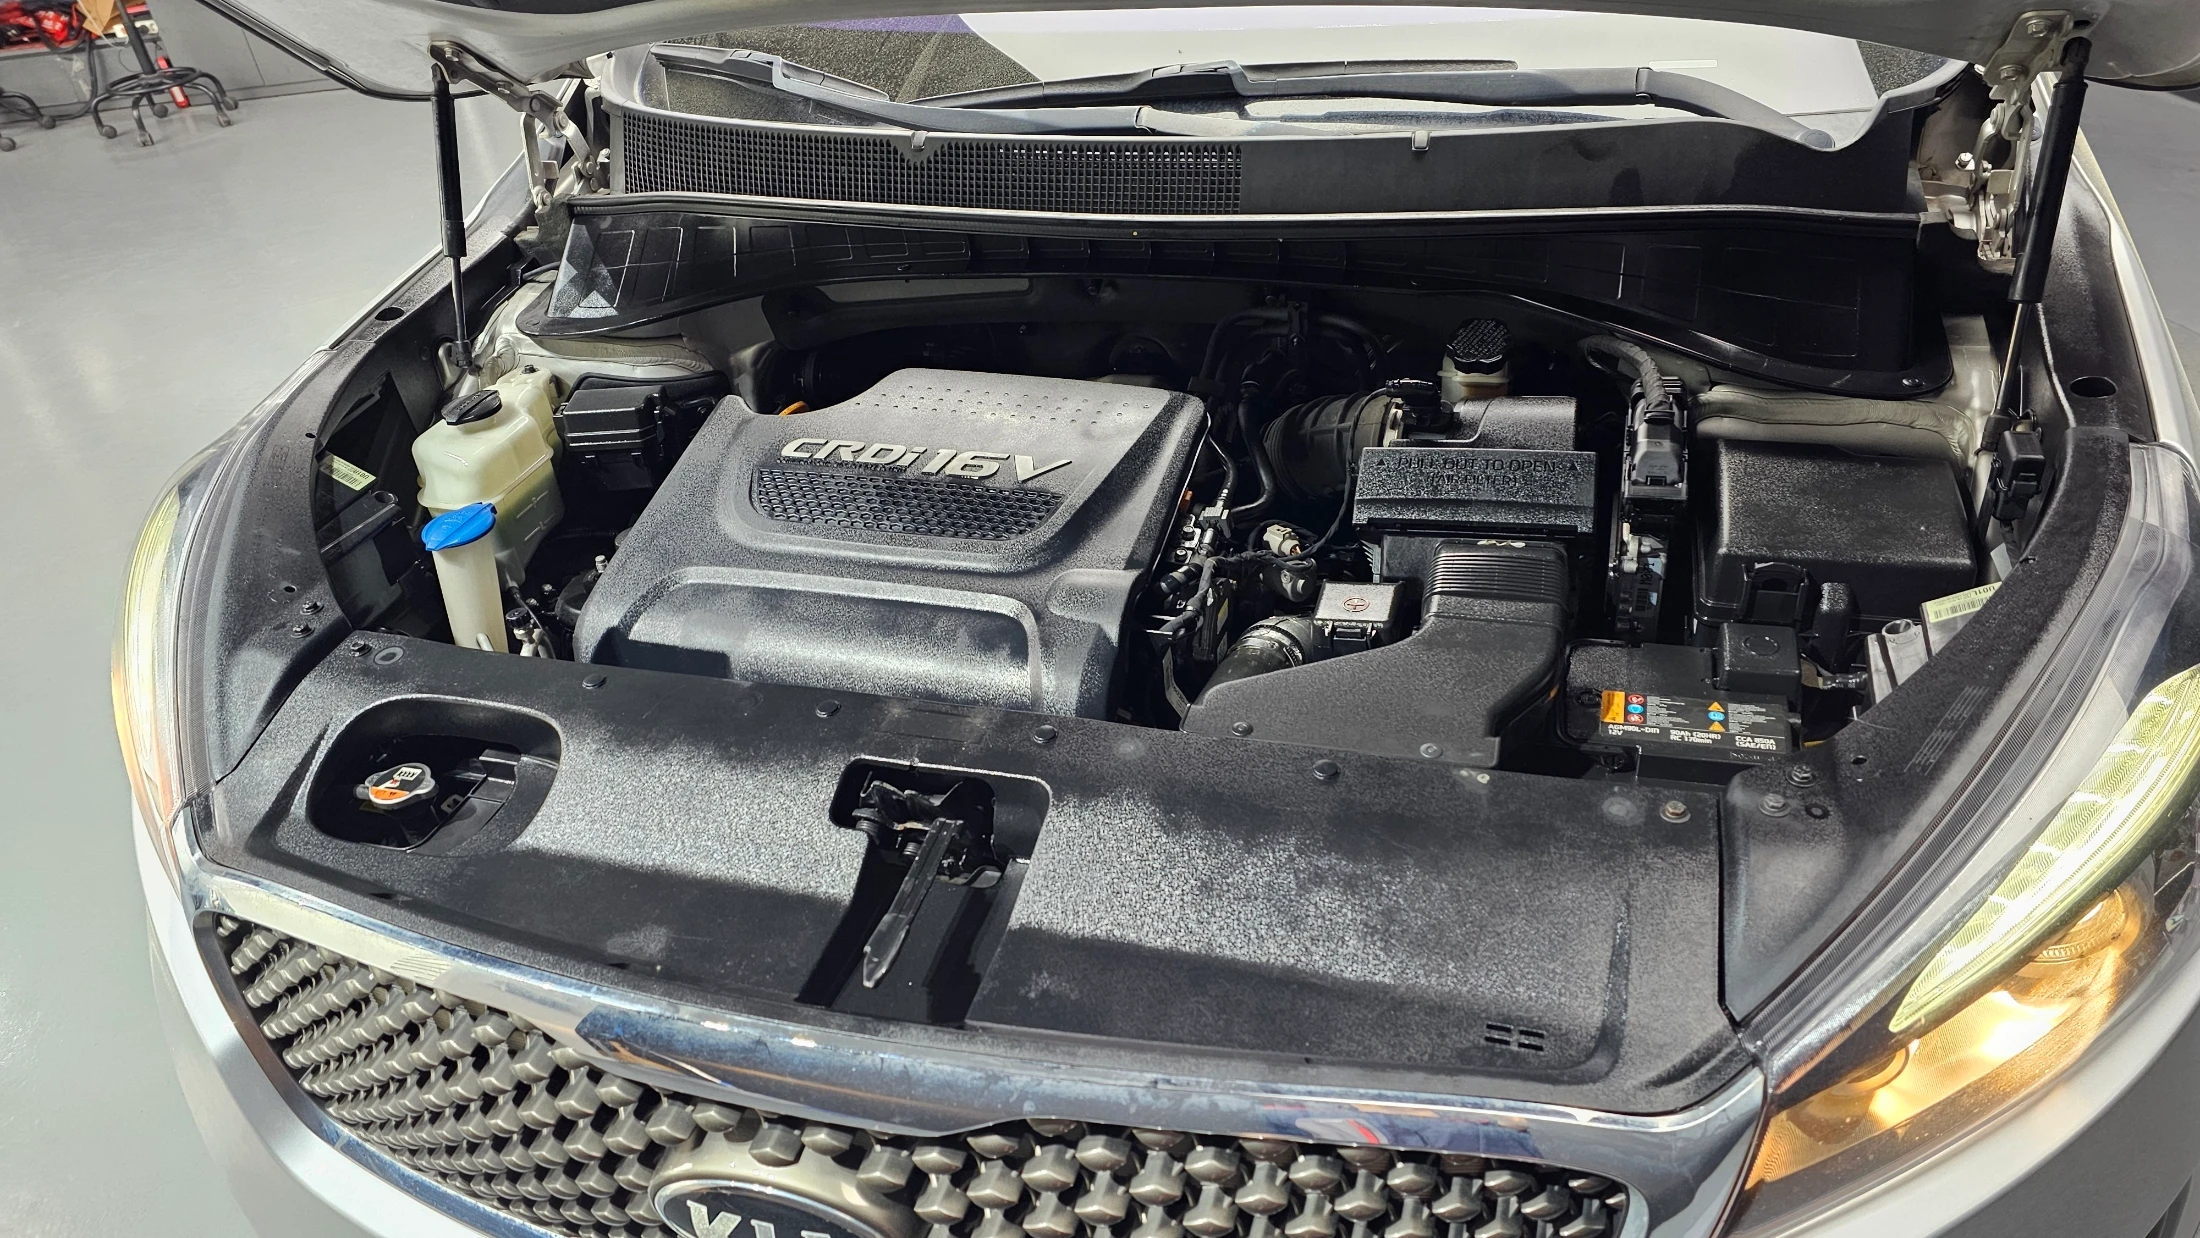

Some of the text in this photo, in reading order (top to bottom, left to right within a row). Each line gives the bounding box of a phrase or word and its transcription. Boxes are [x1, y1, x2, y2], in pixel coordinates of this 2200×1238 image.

[781, 437, 927, 467] CRDi
[1398, 457, 1556, 473] PULL OUT TO OPEN
[1735, 735, 1753, 743] CCA
